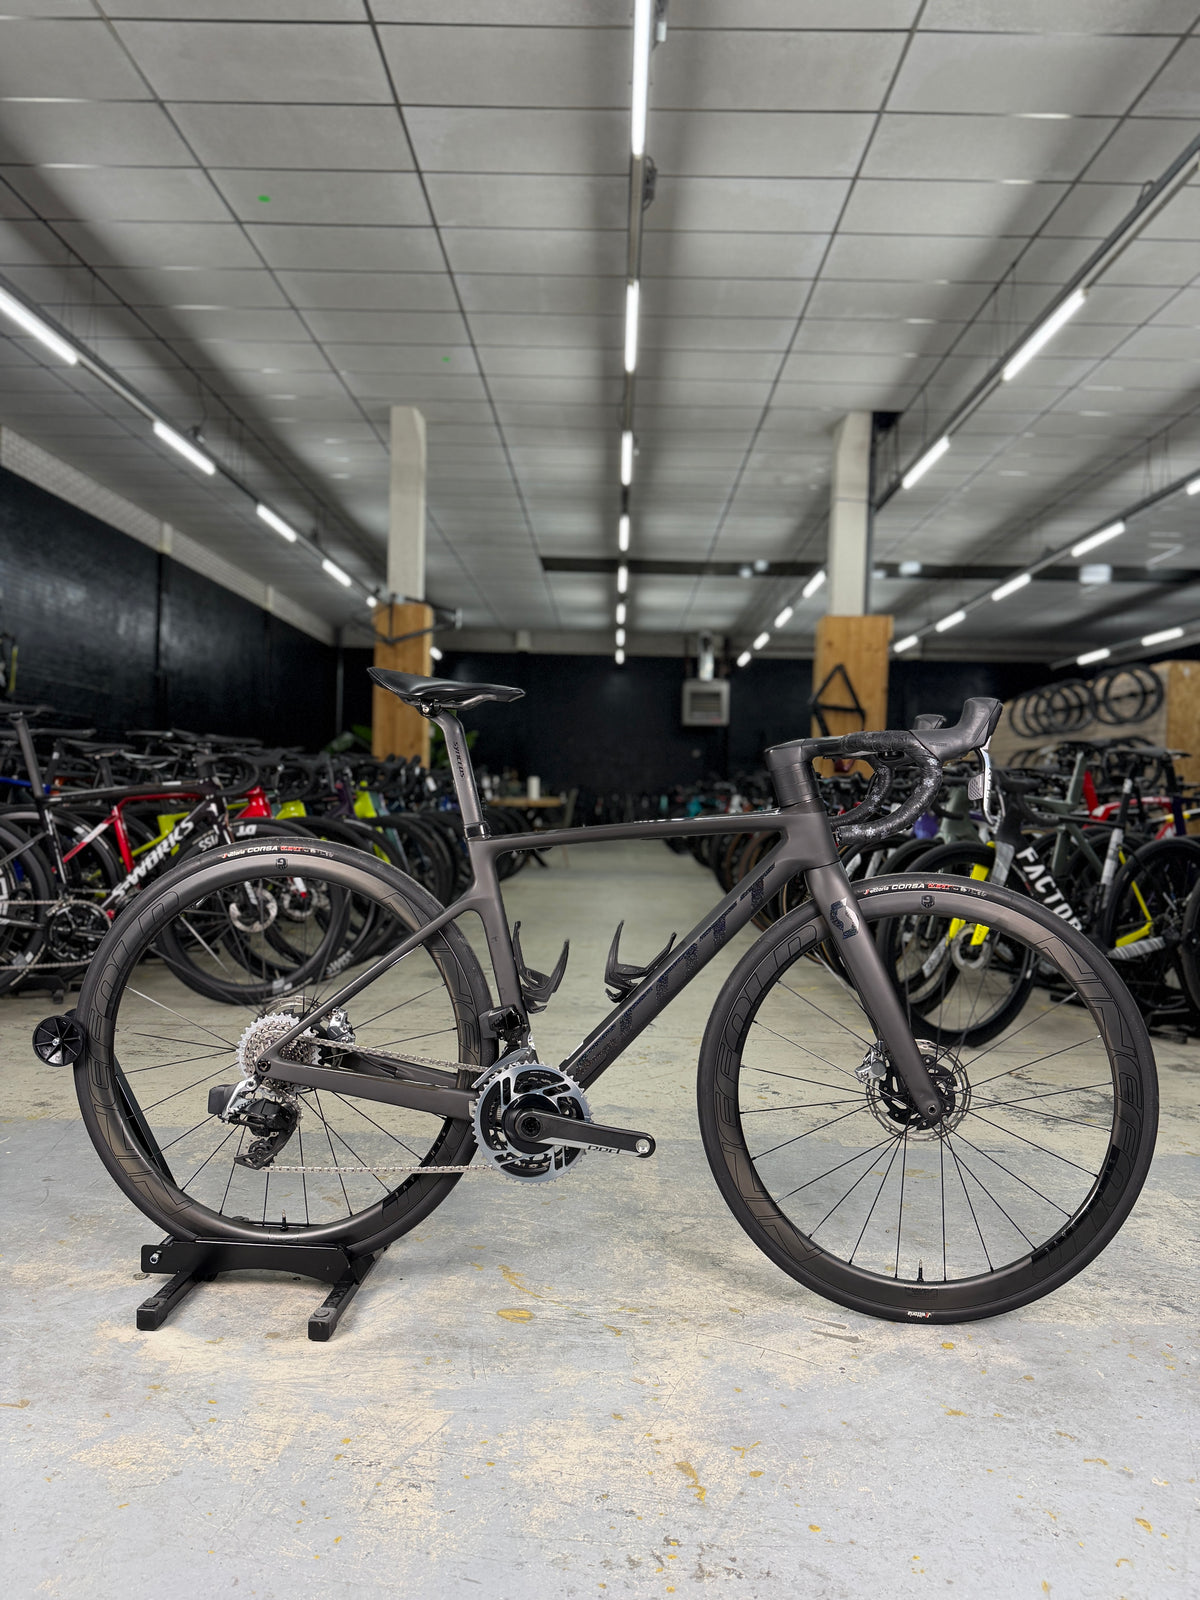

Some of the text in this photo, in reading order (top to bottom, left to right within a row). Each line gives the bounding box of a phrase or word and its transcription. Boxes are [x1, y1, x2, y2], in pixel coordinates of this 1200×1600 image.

[236, 824, 257, 837] DT
[247, 845, 278, 853] CORSA
[112, 821, 194, 897] S-WORKS
